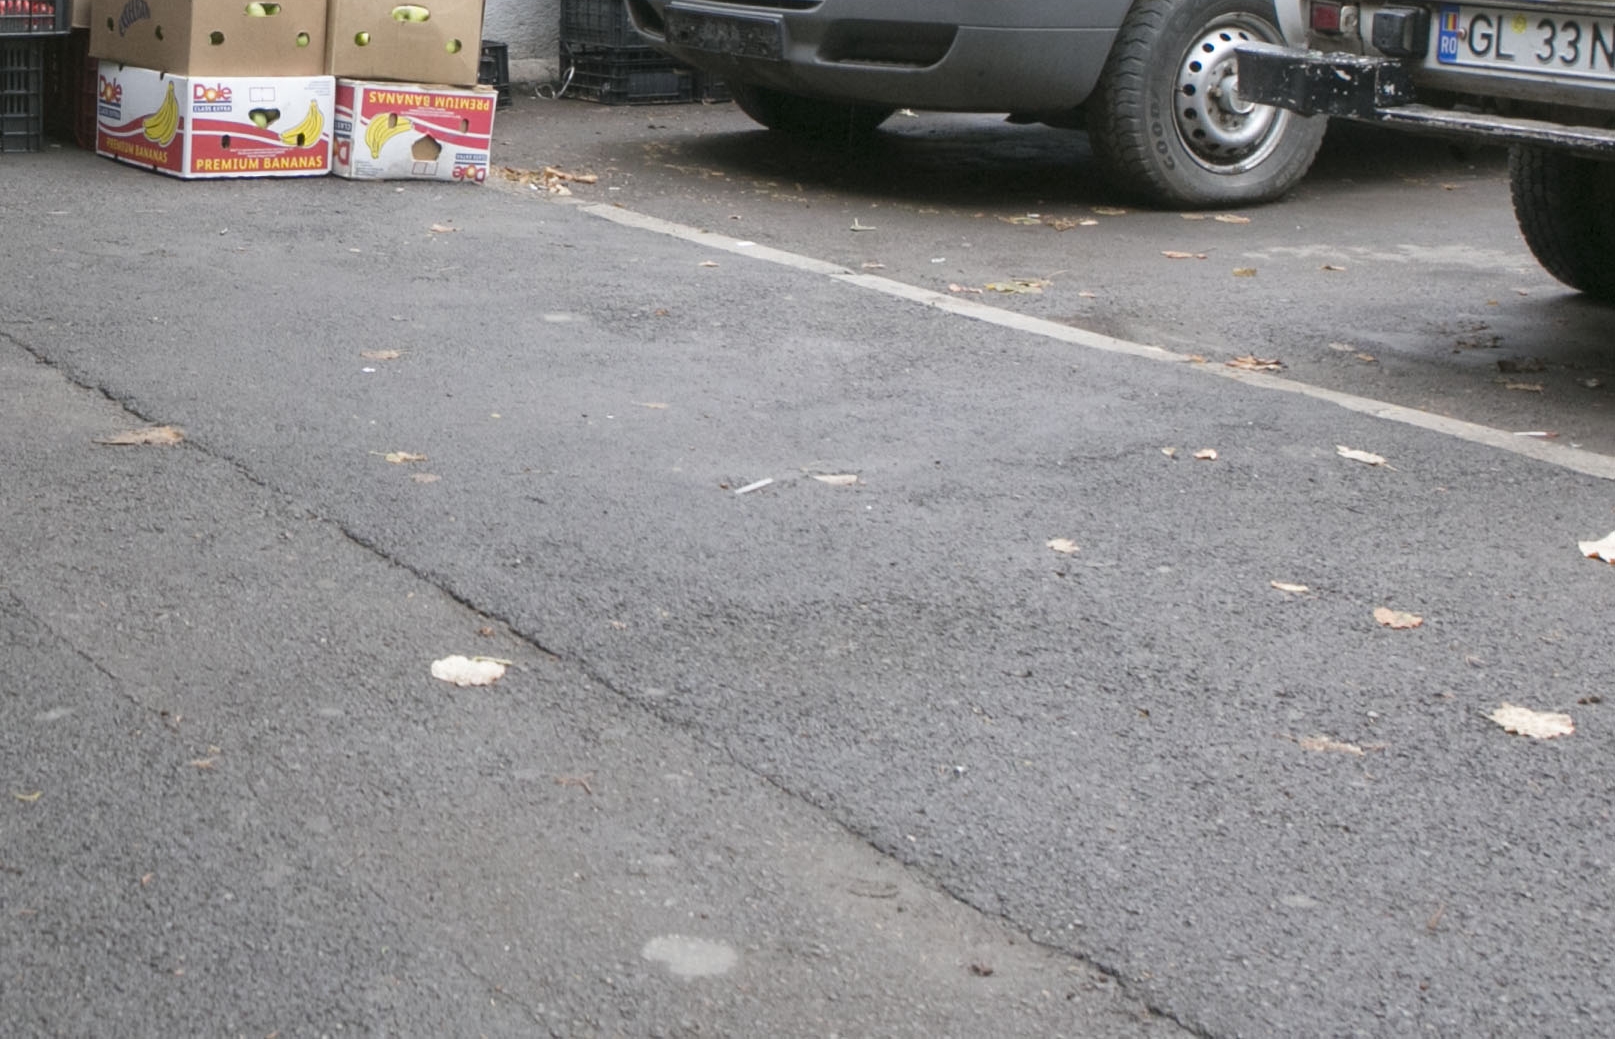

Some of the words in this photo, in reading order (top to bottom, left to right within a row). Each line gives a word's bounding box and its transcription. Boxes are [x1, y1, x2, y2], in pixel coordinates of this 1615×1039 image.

[1440, 36, 1457, 54] RO
[1467, 13, 1515, 61] GL
[99, 73, 122, 104] Dole
[193, 83, 232, 104] Dole
[369, 91, 431, 107] BANANAS
[434, 96, 490, 111] PREMIUM
[135, 144, 168, 163] BANANAS
[196, 158, 259, 171] PREMIUM
[263, 155, 323, 169] BANANAS
[452, 163, 486, 184] Dole
